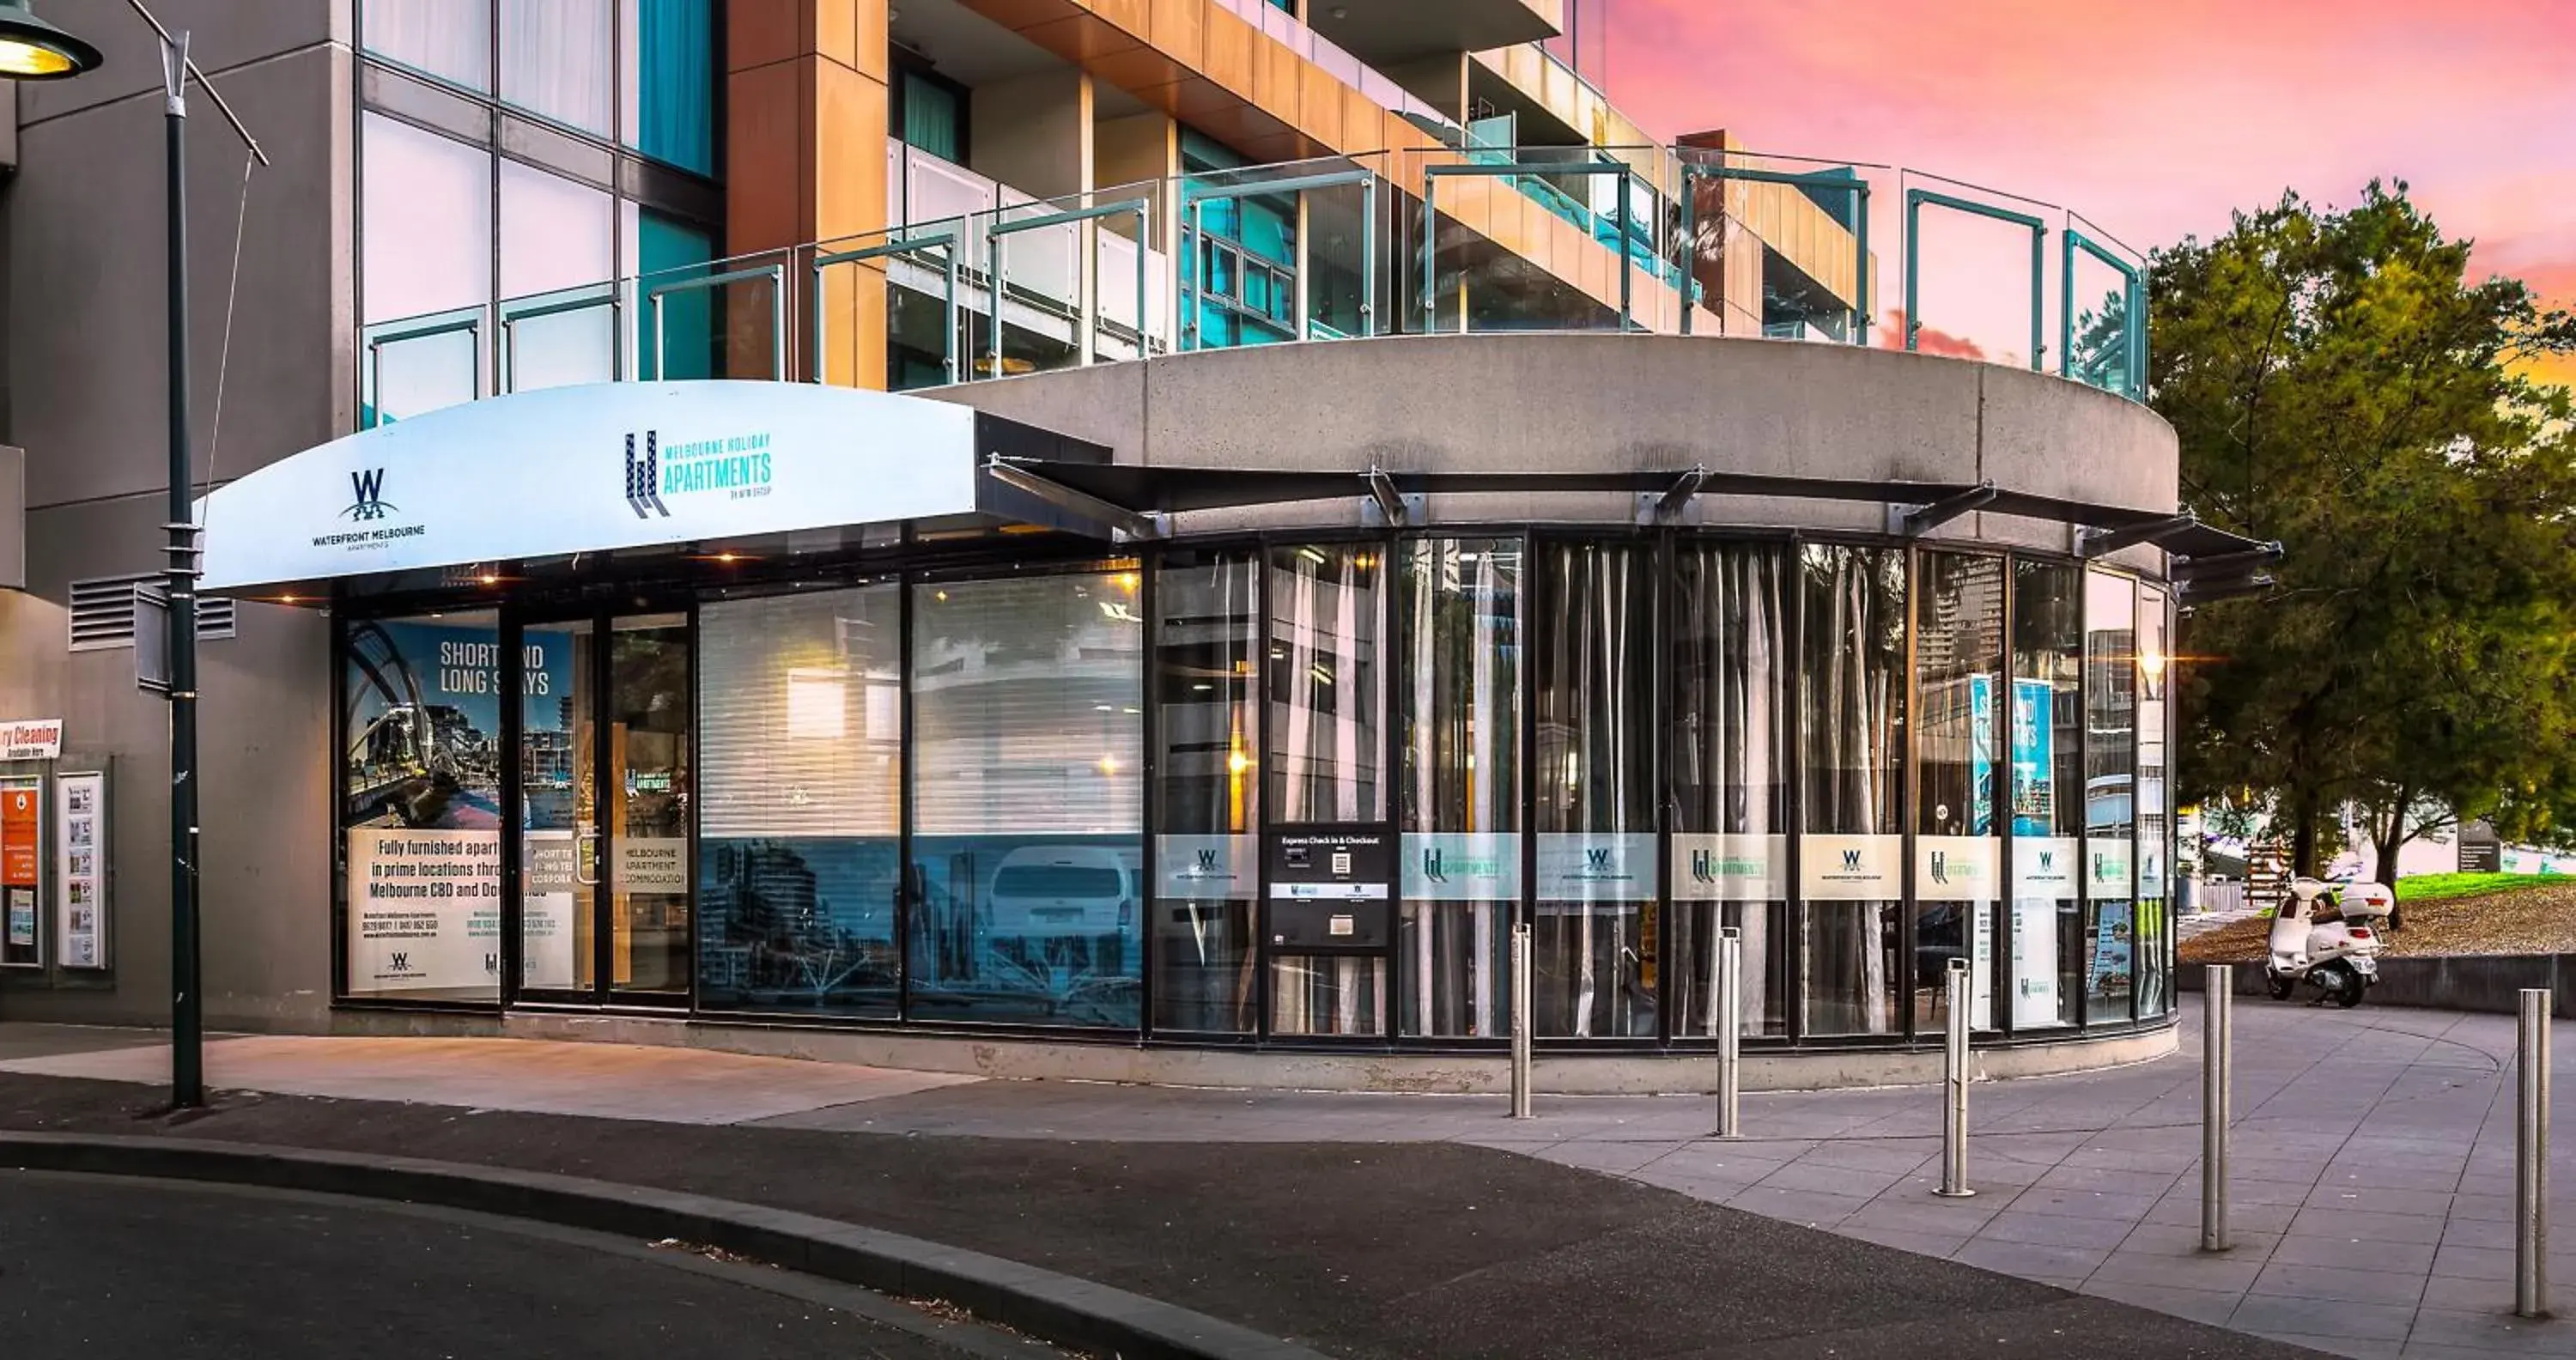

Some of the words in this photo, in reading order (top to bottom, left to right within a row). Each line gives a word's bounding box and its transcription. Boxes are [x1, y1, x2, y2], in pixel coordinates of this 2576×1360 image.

[665, 439, 723, 460] MELBOURNE
[727, 433, 770, 452] HOLIDAY
[664, 452, 771, 494] APARTMENTS
[351, 467, 385, 504] W
[313, 531, 369, 546] WATERFRONT
[372, 525, 425, 540] MELBOURNE
[440, 641, 499, 666] SHORT
[440, 668, 487, 694] LONG
[15, 726, 58, 746] Cleaning
[379, 840, 404, 857] Fully
[408, 840, 462, 855] furnished
[1282, 836, 1308, 845] Express
[626, 848, 677, 858] MELBOURNE
[1588, 849, 1607, 864] W
[1844, 849, 1861, 864] W
[372, 862, 382, 877] in
[384, 862, 416, 878] prime
[419, 862, 472, 877] locations
[626, 861, 676, 870] APARTMENT
[370, 883, 428, 898] Melbourne
[430, 883, 453, 897] CBD
[457, 883, 478, 897] and
